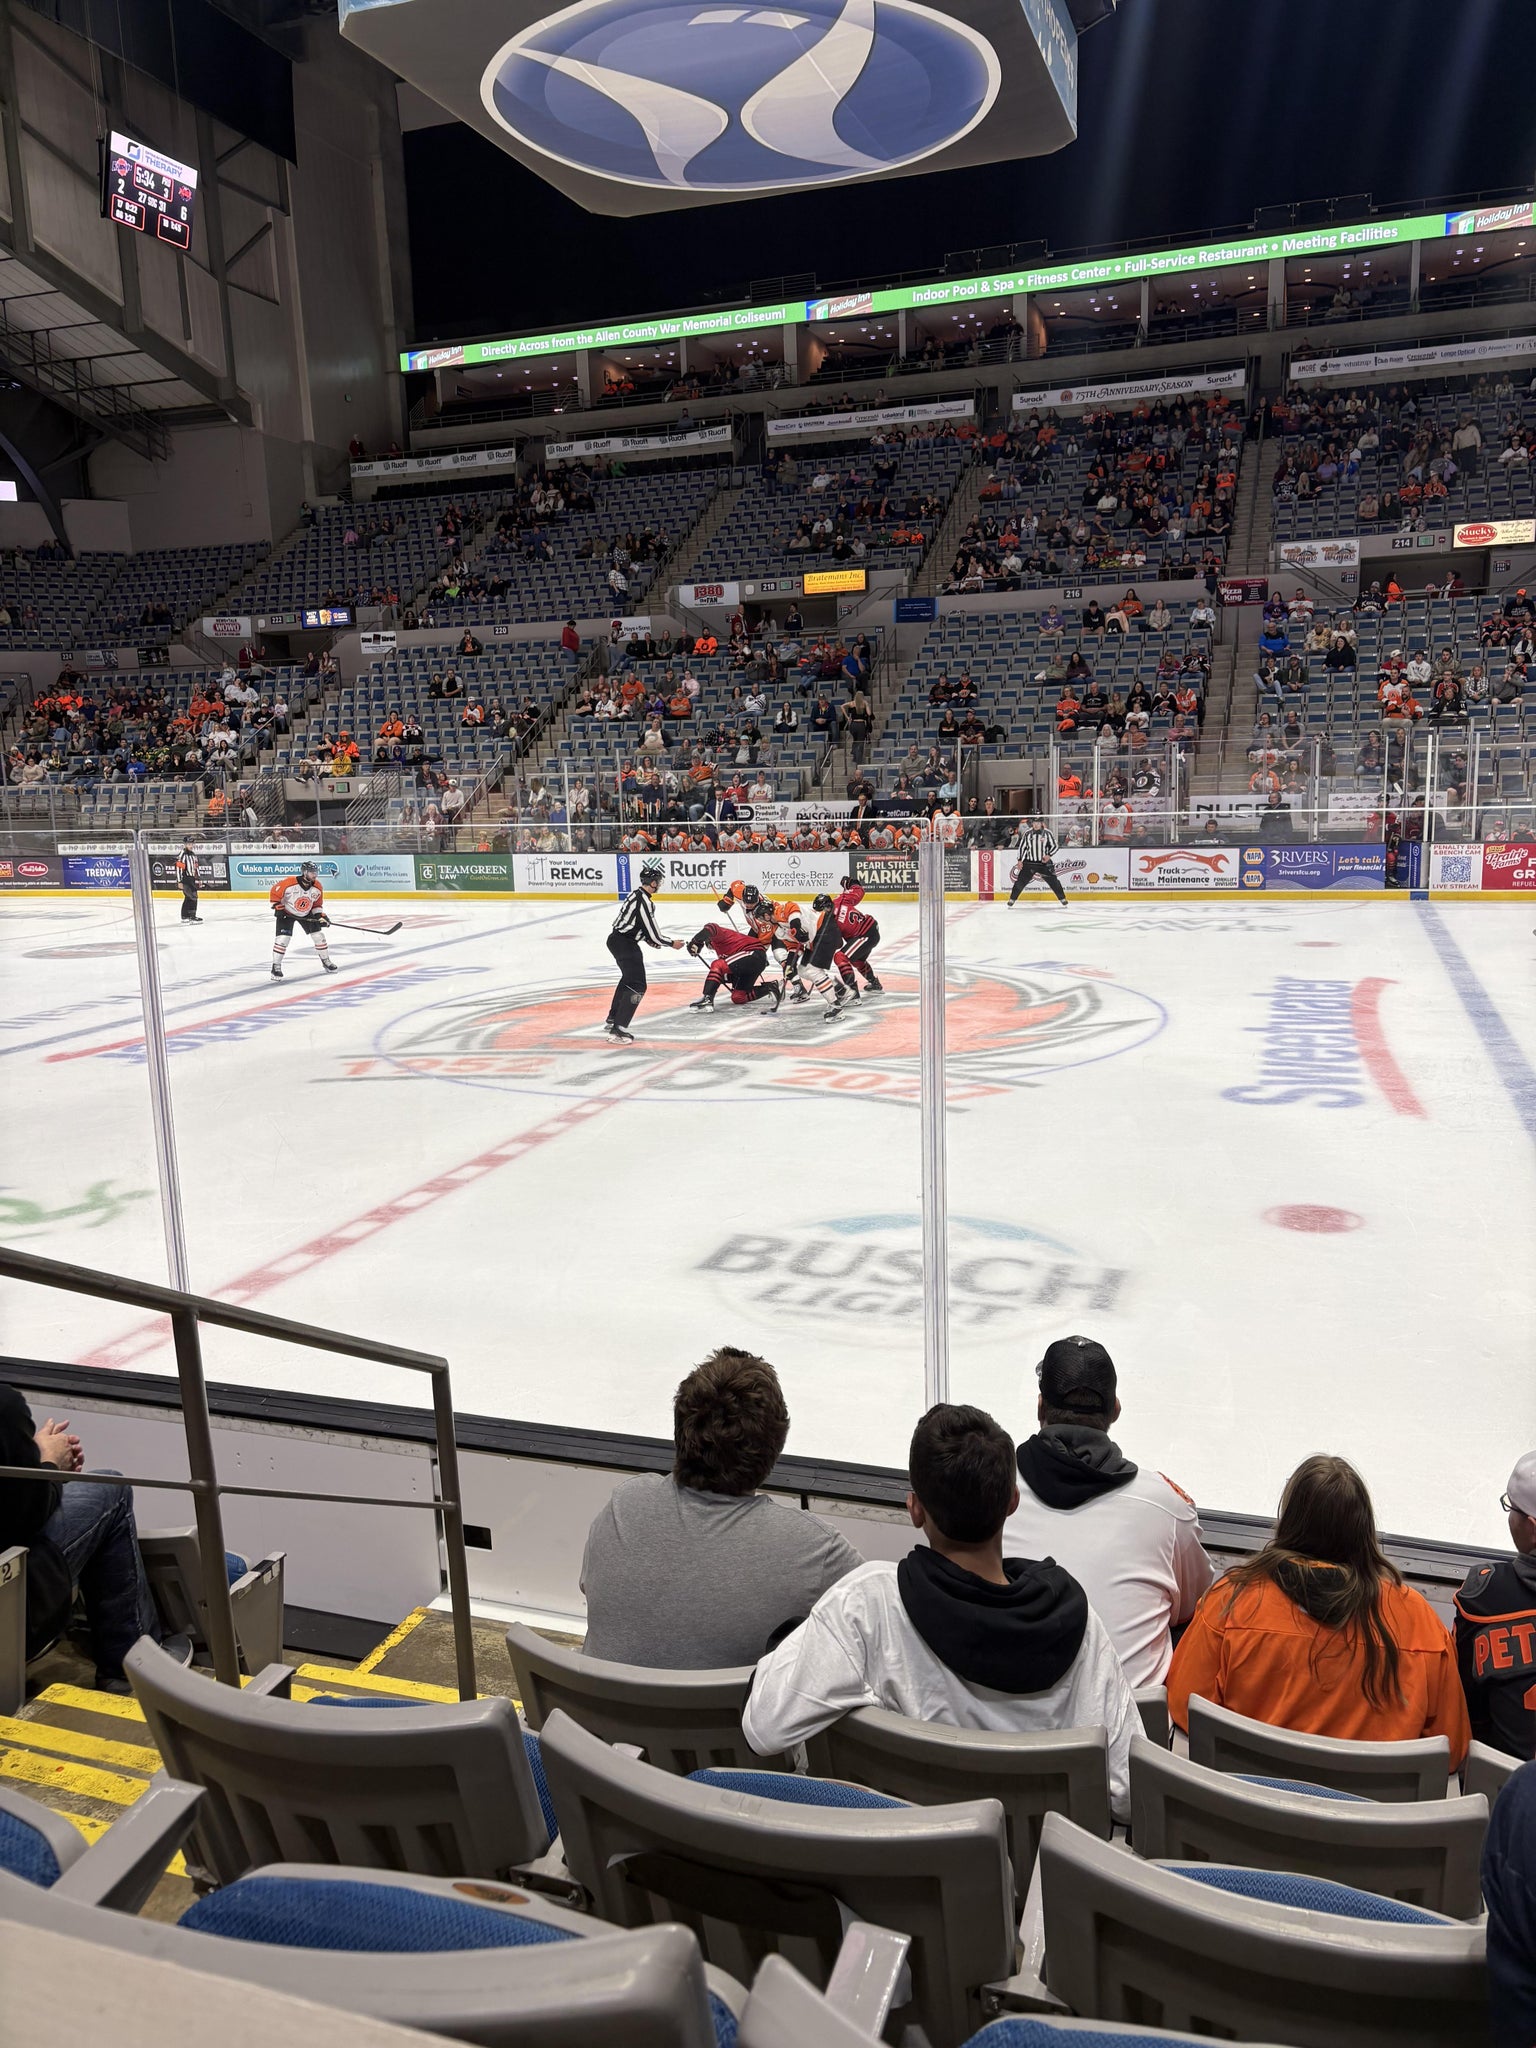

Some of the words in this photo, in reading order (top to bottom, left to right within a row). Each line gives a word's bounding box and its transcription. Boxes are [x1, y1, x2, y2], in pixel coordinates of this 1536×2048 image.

[145, 155, 183, 177] THERAPY
[136, 168, 156, 189] 5:34
[118, 178, 125, 194] 2
[138, 192, 147, 204] 27
[163, 188, 170, 198] 3
[180, 206, 188, 220] 6
[1476, 209, 1511, 231] Holiday
[1512, 202, 1530, 220] Inn
[912, 287, 950, 302] Indoor
[952, 283, 978, 298] Pool
[981, 281, 991, 293] &
[993, 278, 1014, 293] Spa
[1028, 272, 1068, 287] Fitness
[1071, 266, 1112, 281] Center
[1124, 255, 1195, 274] Full-Service
[1199, 245, 1268, 264] Restaurant
[1282, 234, 1337, 254] Meeting
[1341, 227, 1398, 244] Facilities
[830, 298, 856, 314] Holiday
[858, 292, 872, 304] Inn
[481, 344, 518, 360] Directly
[519, 340, 551, 353] Across
[552, 337, 574, 348] from
[576, 335, 594, 346] the
[595, 331, 622, 344] Allen
[622, 324, 658, 341] County
[660, 321, 681, 335] War
[683, 316, 733, 333] Memorial
[734, 309, 786, 326] Coliseum!
[429, 352, 451, 366] Holiday
[1208, 374, 1233, 384] Surack
[1076, 392, 1096, 402] 75TH
[1097, 382, 1160, 399] ANNIVERSARY
[1158, 380, 1194, 394] SEASON
[1020, 396, 1044, 404] Surack
[708, 428, 727, 437] Ruoff
[630, 438, 648, 446] Ruoff
[668, 434, 687, 443] Ruoff
[556, 444, 574, 452] Ruoff
[592, 440, 611, 449] Ruoff
[460, 454, 478, 462] Ruoff
[495, 450, 512, 459] Ruoff
[391, 461, 408, 470] Ruoff
[424, 458, 442, 466] Ruoff
[357, 464, 374, 472] Ruoff
[1394, 540, 1410, 548] 214
[694, 584, 724, 600] 1380
[1066, 590, 1080, 598] 216
[1224, 594, 1242, 602] King
[272, 616, 282, 624] 222
[1338, 856, 1360, 864] Let's
[1362, 856, 1381, 864] talk
[1486, 848, 1528, 864] Prairie
[670, 860, 727, 877] Ruoff
[856, 861, 886, 869] PEARL
[85, 868, 123, 878] TREDWAY
[550, 868, 603, 880] REMCs
[762, 871, 834, 879] Mercedes-Benz
[671, 880, 728, 890] MORTGAGE
[1158, 876, 1210, 884] Maintenance
[1219, 975, 1366, 1109] Sweetwater
[344, 1056, 557, 1077] 1952
[696, 1232, 1128, 1312] BUSCH
[2, 1562, 12, 1584] 2
[1474, 1622, 1536, 1677] PET
